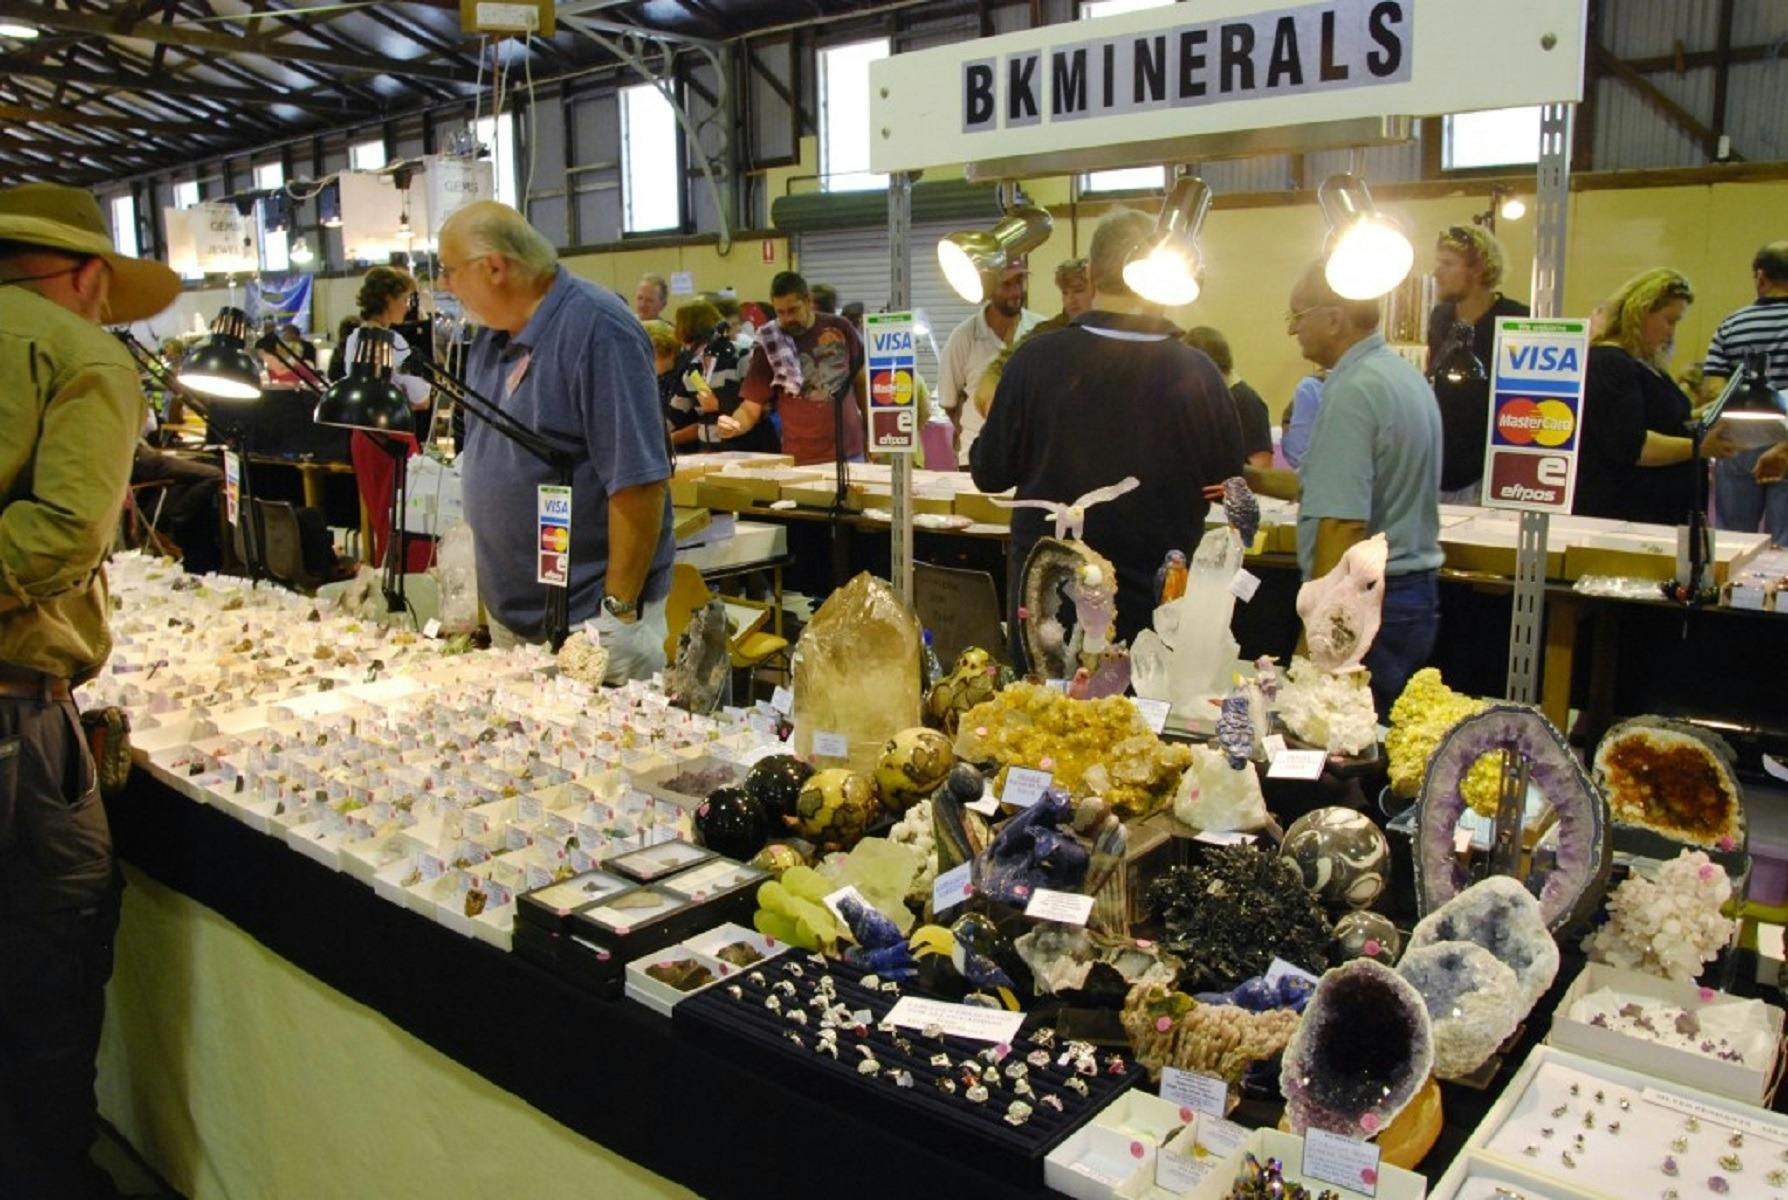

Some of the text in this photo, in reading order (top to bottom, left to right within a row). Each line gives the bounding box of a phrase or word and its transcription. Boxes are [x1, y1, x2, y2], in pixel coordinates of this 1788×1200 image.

[873, 331, 912, 351] VISA
[1507, 345, 1579, 372] VISA
[1499, 413, 1571, 431] MasterCard
[1537, 457, 1566, 487] e
[1501, 482, 1556, 502] eftpos
[545, 499, 568, 513] VISA
